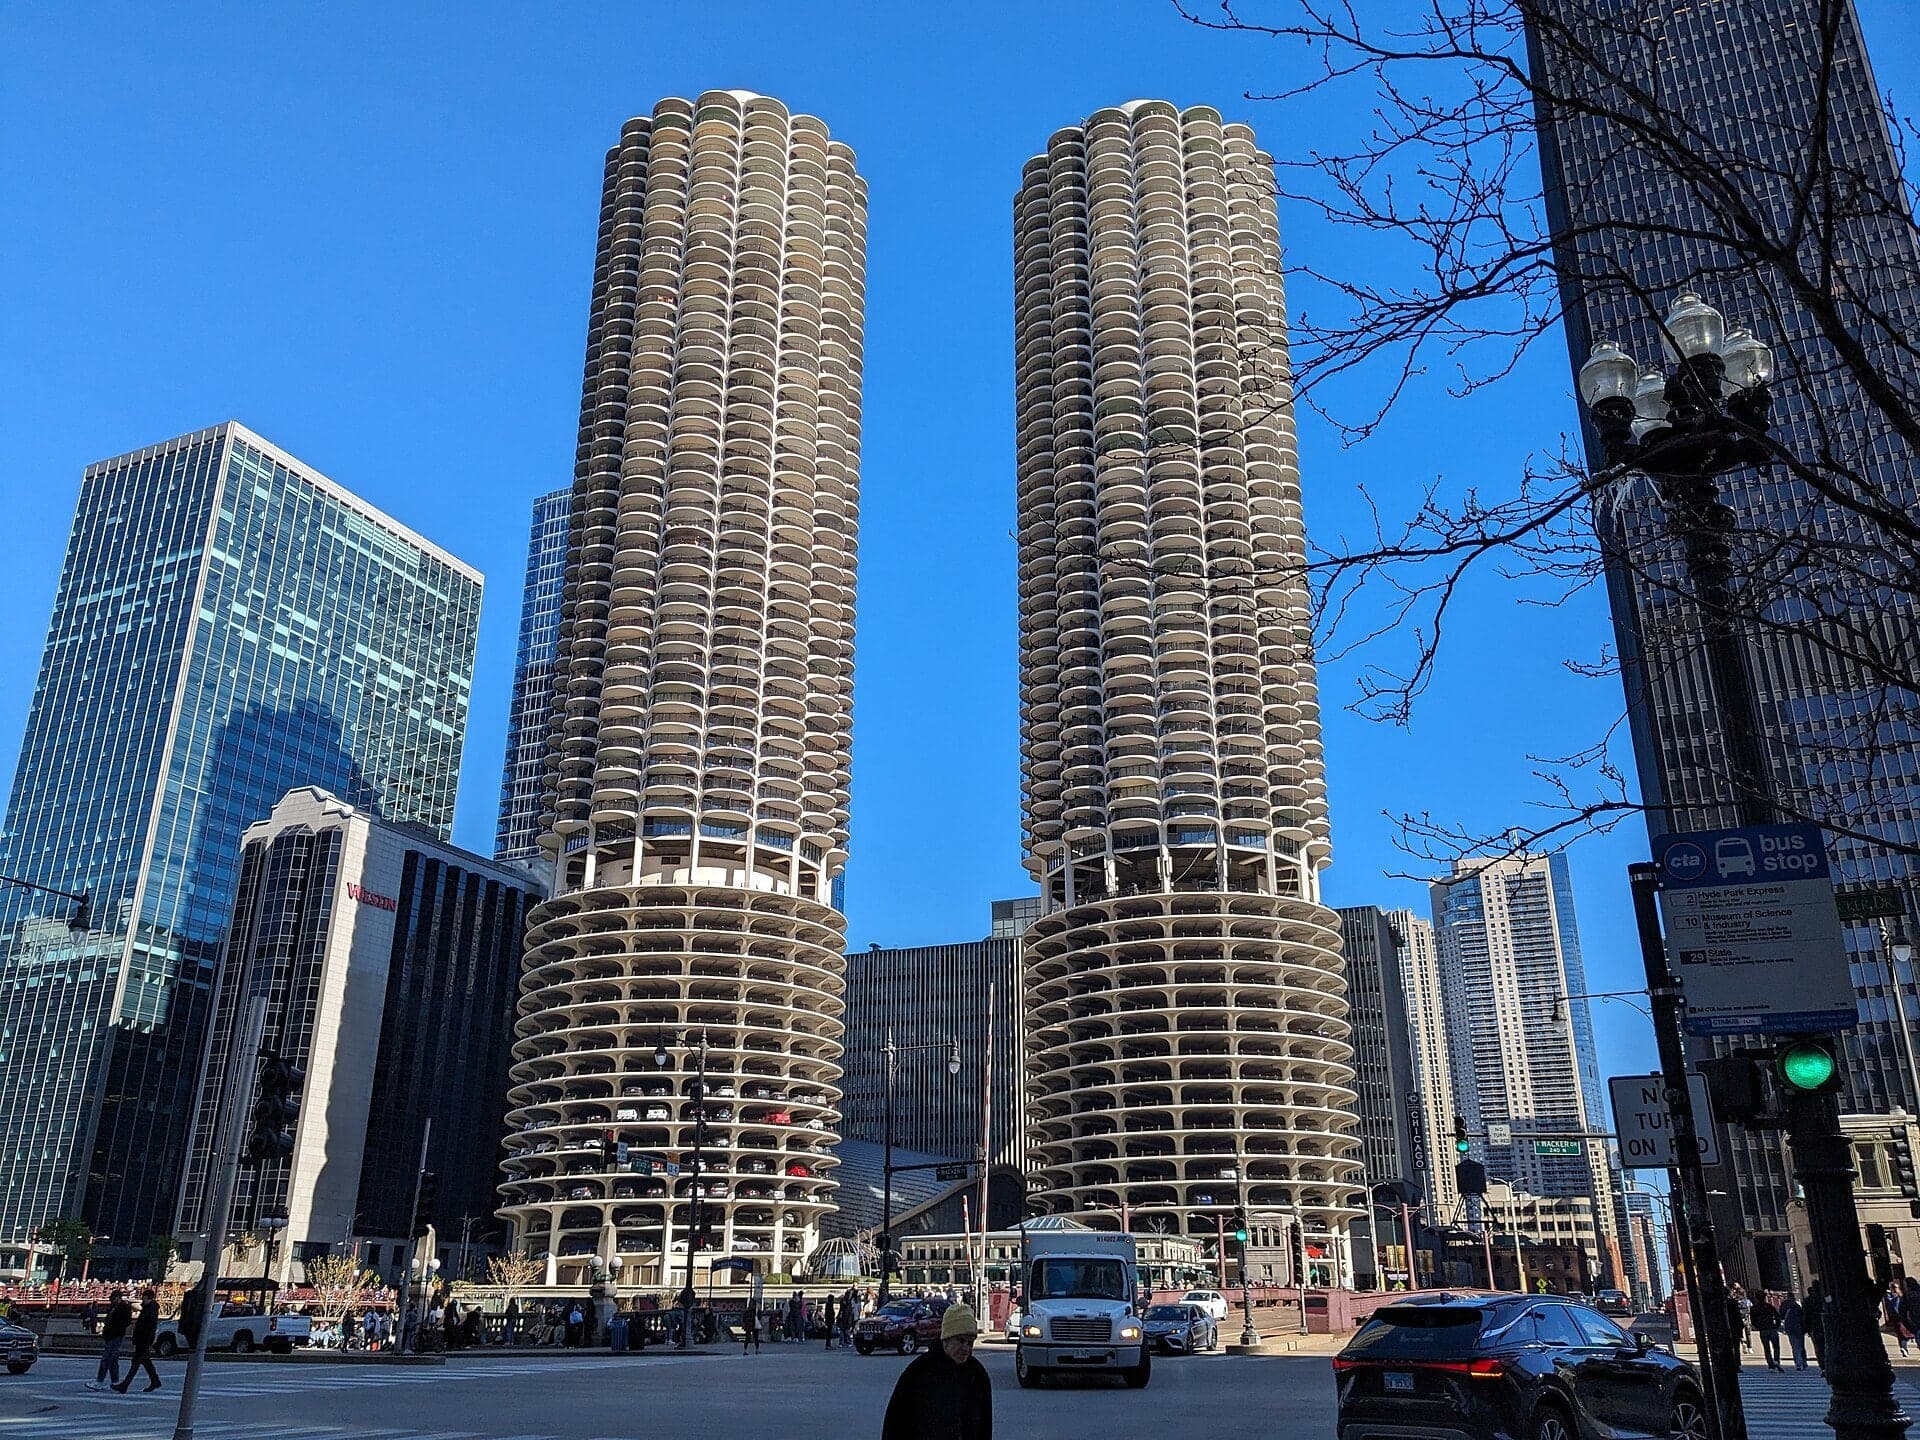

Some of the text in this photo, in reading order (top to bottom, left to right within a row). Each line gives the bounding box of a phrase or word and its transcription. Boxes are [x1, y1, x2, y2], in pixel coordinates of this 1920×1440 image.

[1760, 834, 1804, 852] bus
[1670, 853, 1700, 868] cta
[1763, 852, 1818, 874] stop
[1686, 894, 1694, 905] 2
[1698, 886, 1784, 900] Hyde Park Express
[1686, 918, 1698, 926] 10
[1702, 909, 1792, 922] Museum of Science
[1713, 920, 1750, 930] Industry
[1690, 953, 1704, 962] 29
[1708, 948, 1732, 957] State
[1410, 1111, 1424, 1168] CHICAGO
[1541, 1140, 1570, 1148] WACKER
[1628, 1138, 1656, 1156] ON
